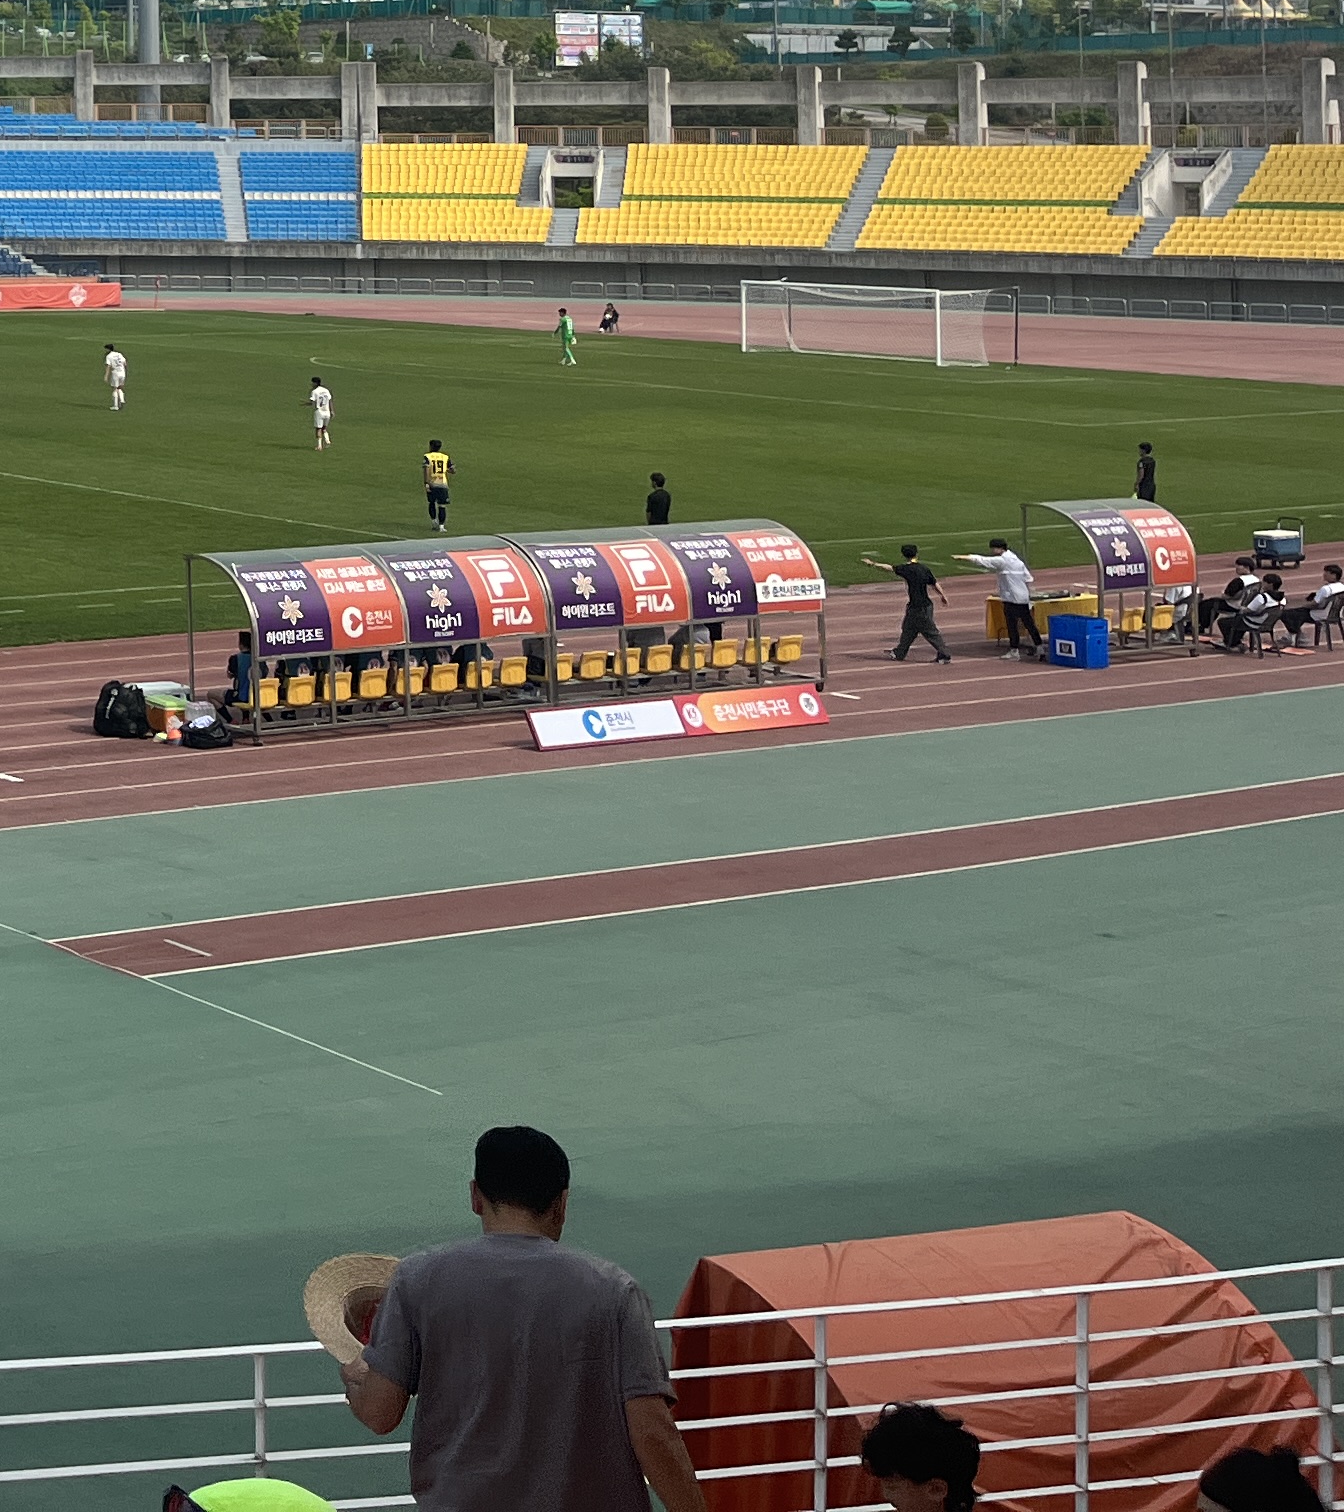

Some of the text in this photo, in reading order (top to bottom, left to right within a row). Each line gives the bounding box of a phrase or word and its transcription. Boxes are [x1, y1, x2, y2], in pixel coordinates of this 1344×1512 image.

[431, 460, 444, 475] 19
[635, 593, 675, 614] FILA
[707, 589, 742, 607] high1
[425, 612, 462, 631] high1
[492, 605, 533, 626] FILA
[605, 710, 634, 726] 춘천시
[712, 698, 792, 722] 춘천시민축구단
